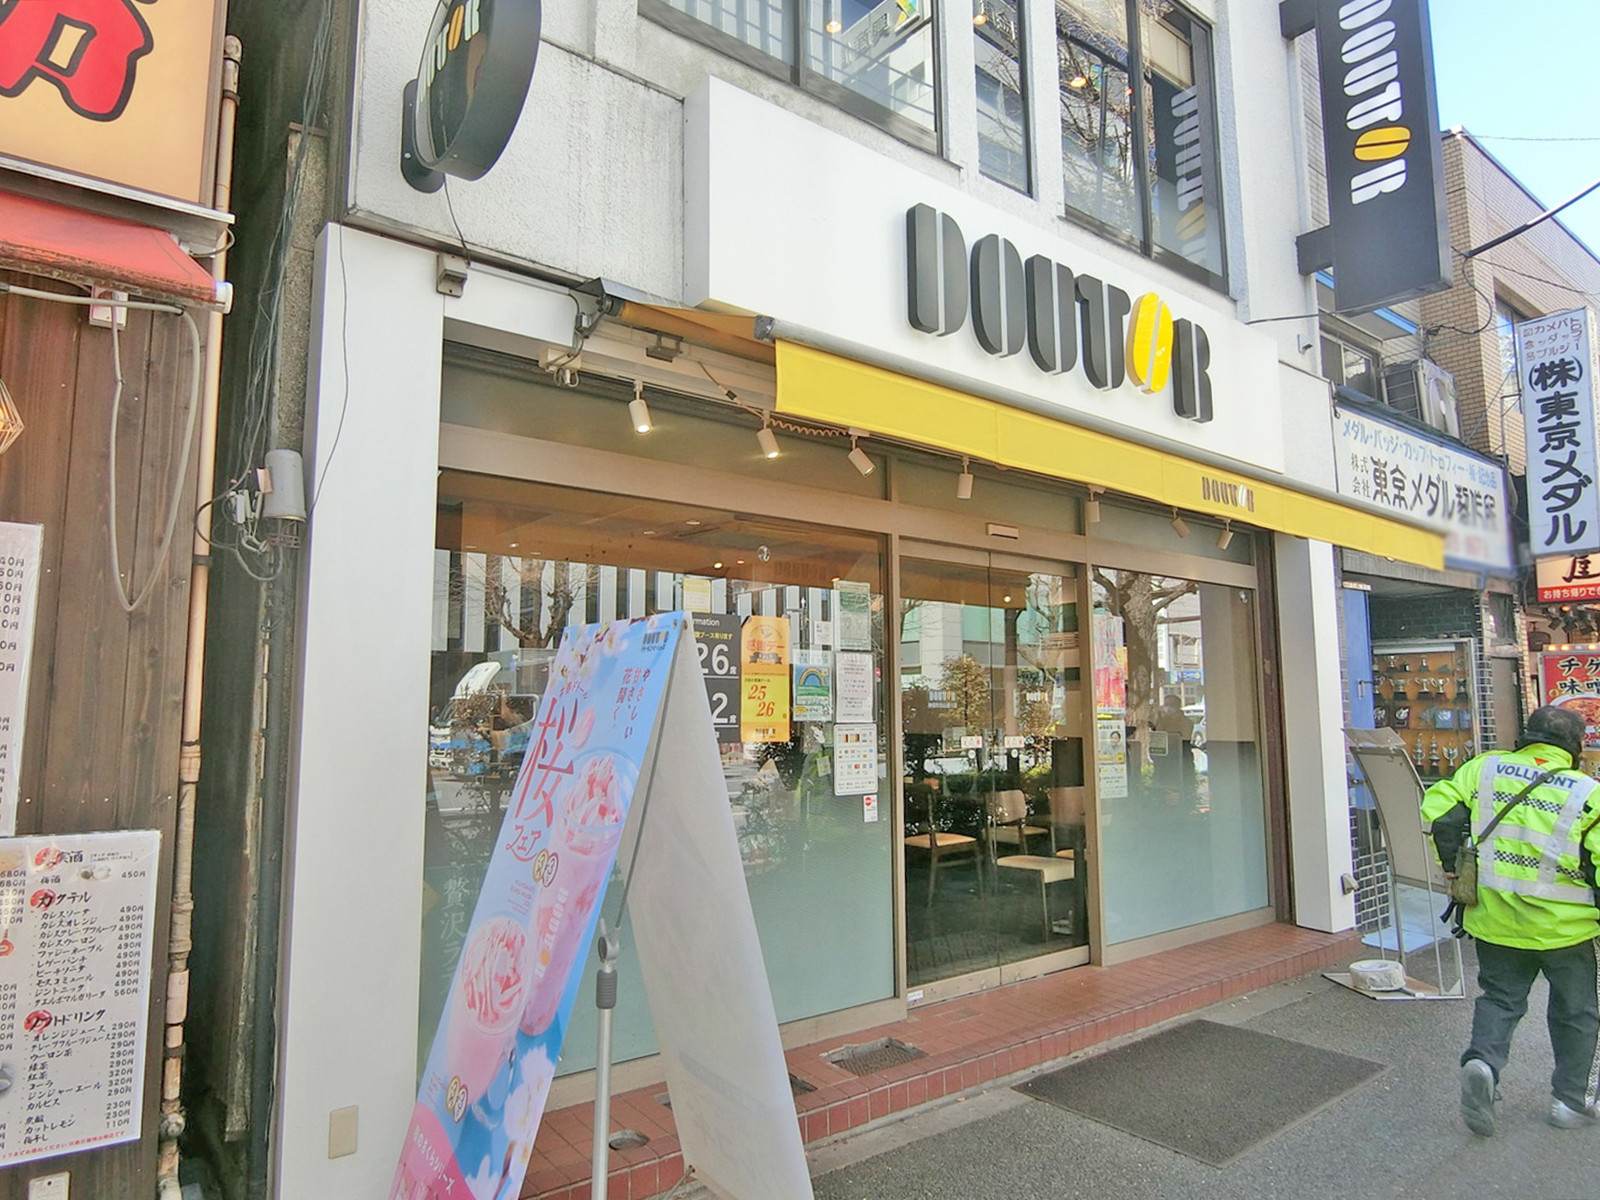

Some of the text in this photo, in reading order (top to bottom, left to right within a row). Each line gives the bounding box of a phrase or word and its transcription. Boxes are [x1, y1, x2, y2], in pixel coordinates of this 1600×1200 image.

[1338, 0, 1412, 205] DOUTOR
[905, 202, 1214, 424] DOUTOR
[1202, 476, 1255, 513] DOUTOR
[624, 667, 652, 750] やさしい
[747, 684, 768, 701] 25
[756, 701, 776, 718] 26
[514, 696, 578, 829] 桜
[506, 824, 541, 861] フェア
